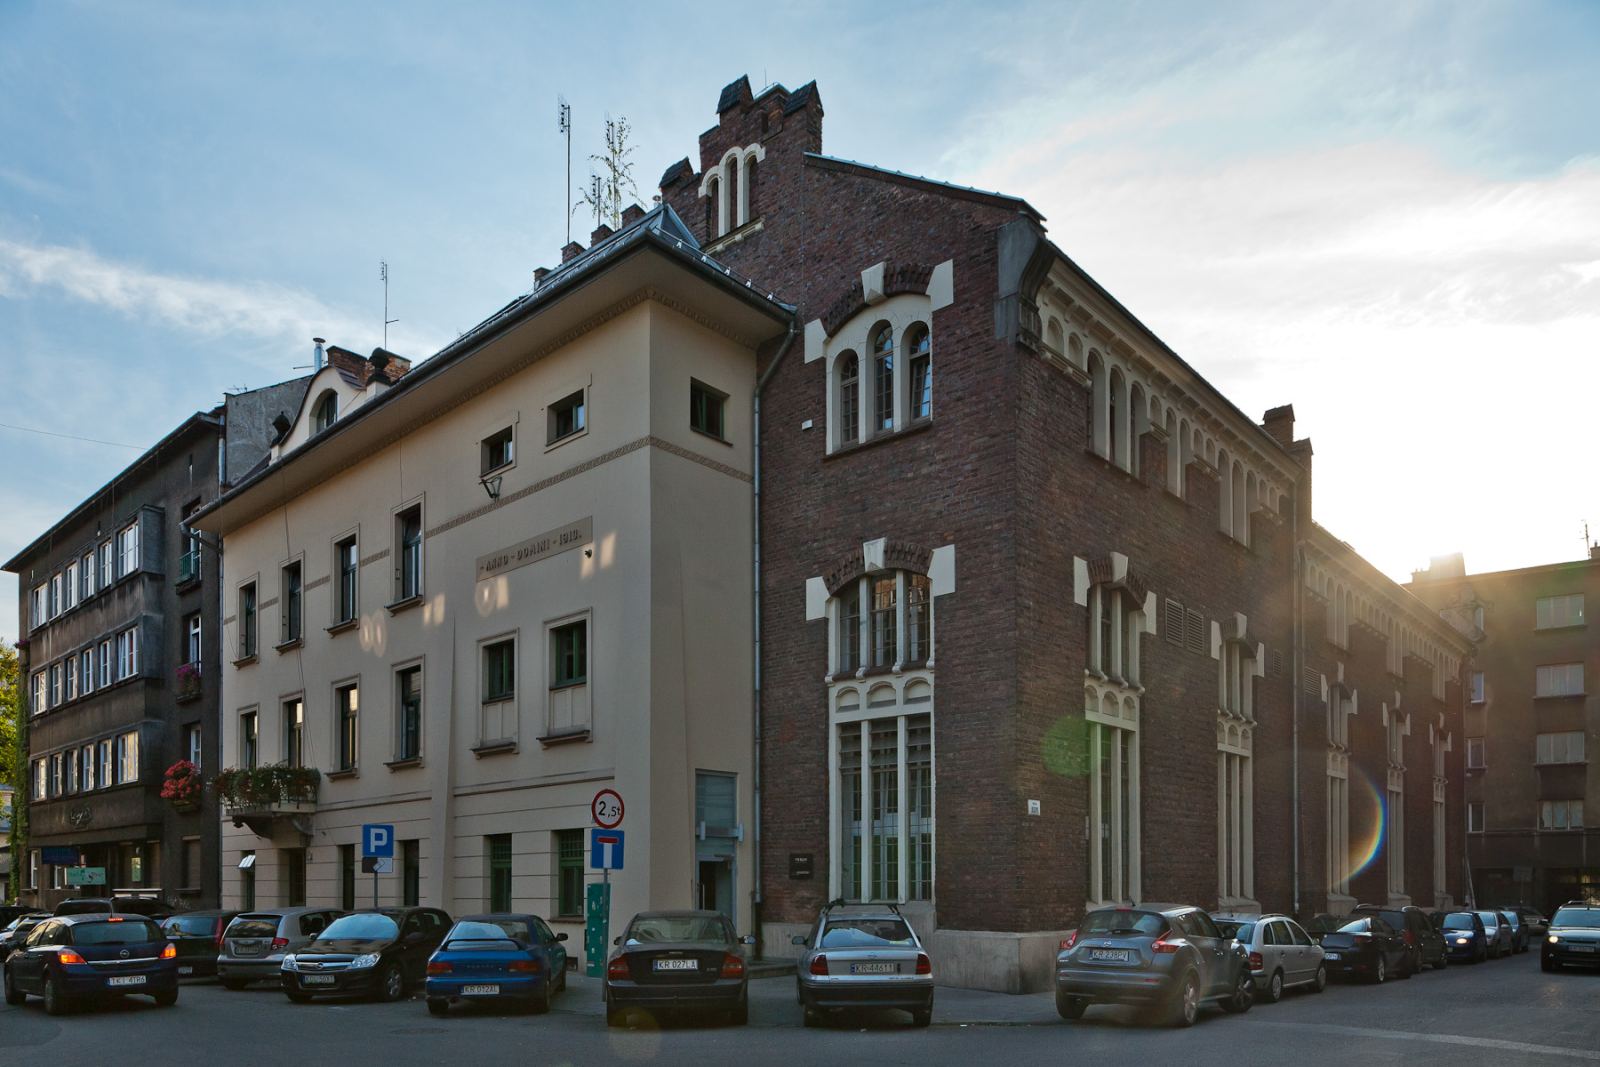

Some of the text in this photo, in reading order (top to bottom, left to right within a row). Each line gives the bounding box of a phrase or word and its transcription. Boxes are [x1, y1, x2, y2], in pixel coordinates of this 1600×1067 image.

[486, 555, 509, 572] ANNO
[517, 539, 550, 561] DOMINI
[598, 800, 621, 818] 2,5t
[370, 828, 387, 853] P
[659, 959, 669, 969] KR
